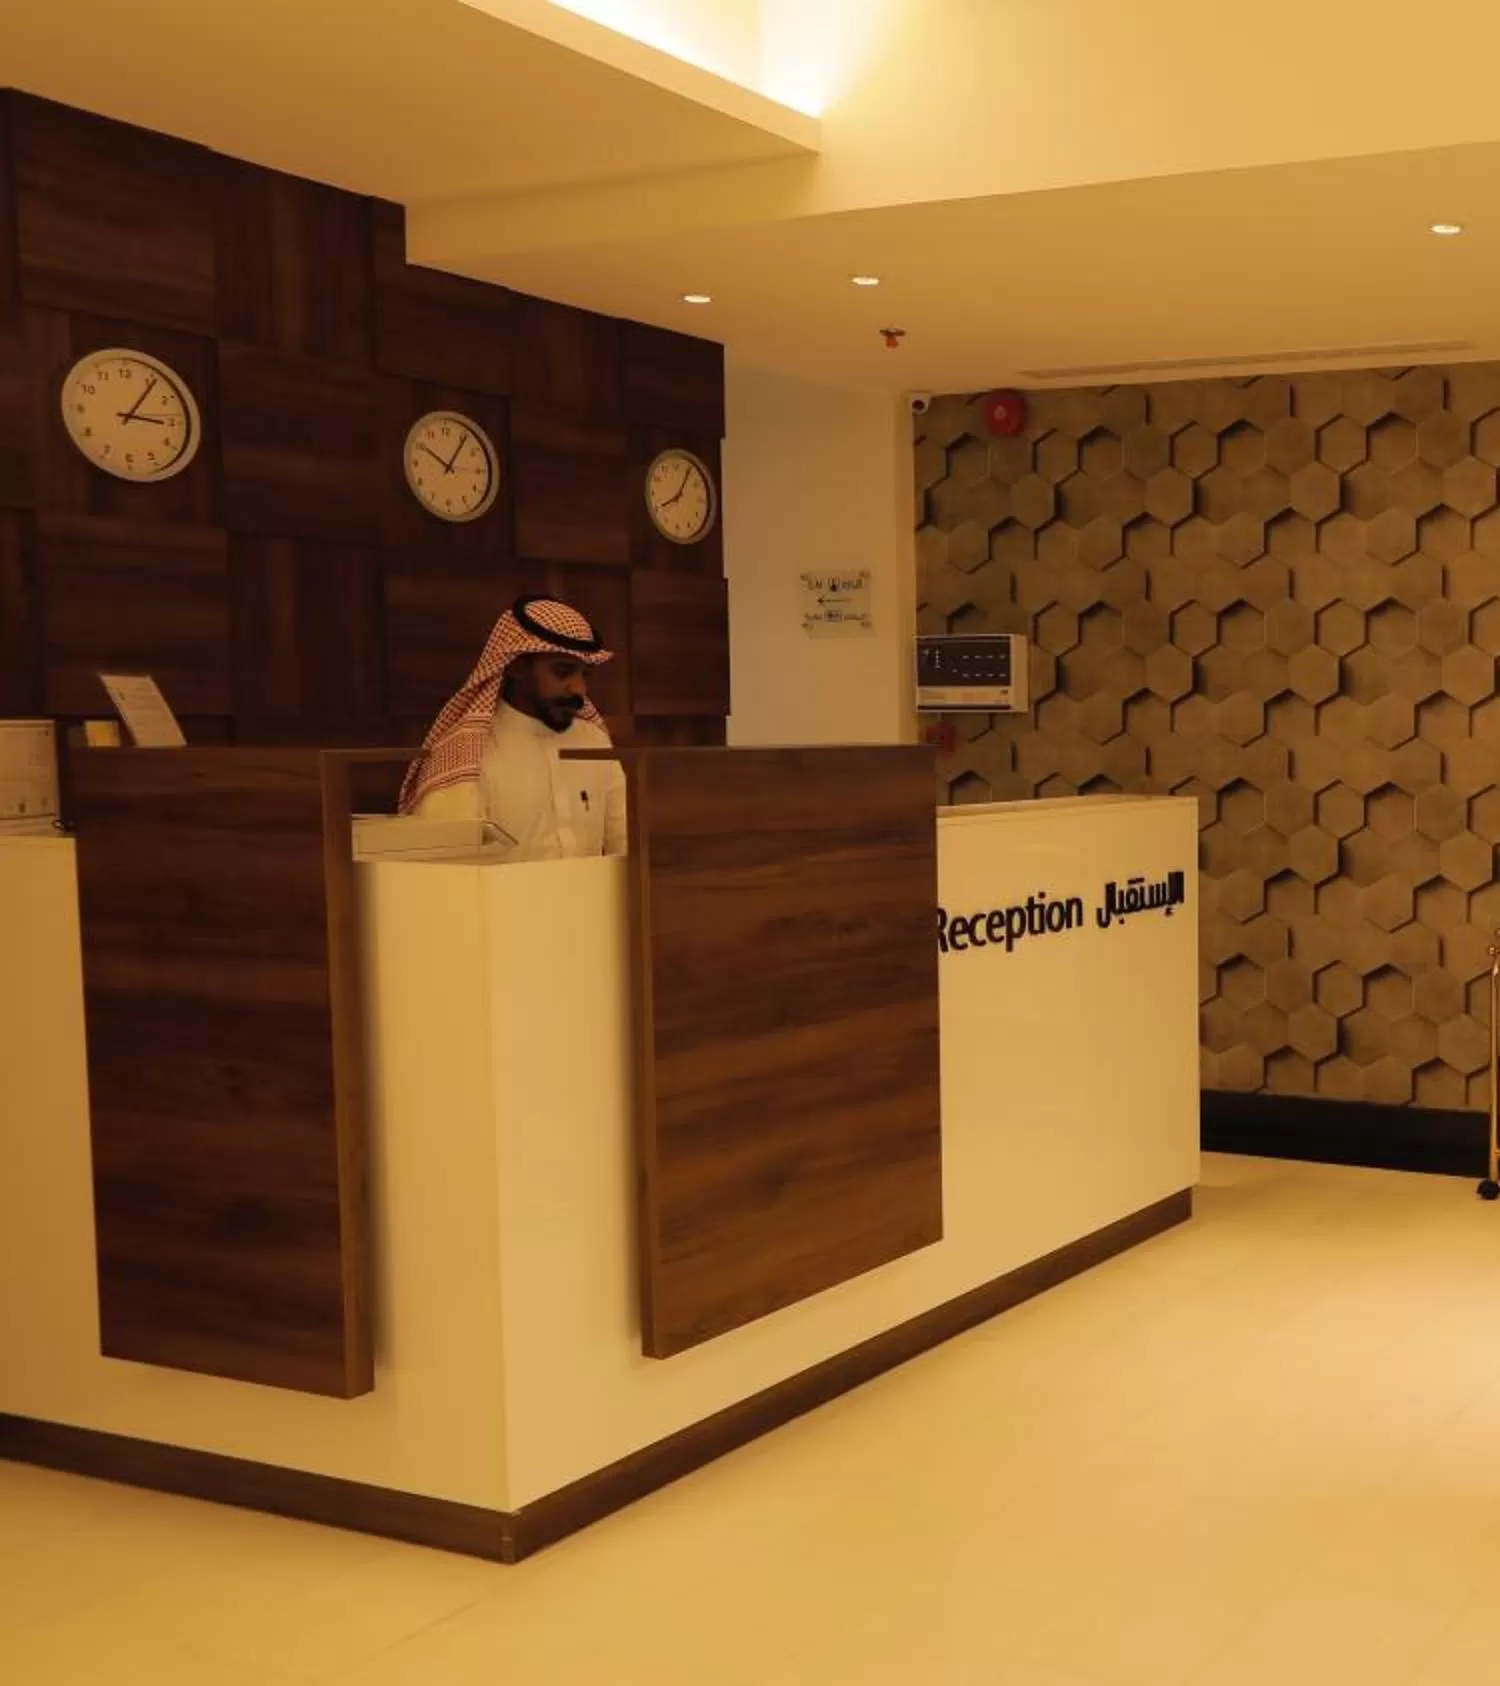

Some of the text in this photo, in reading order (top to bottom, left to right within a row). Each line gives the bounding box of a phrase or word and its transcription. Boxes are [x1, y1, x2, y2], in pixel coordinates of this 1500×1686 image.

[98, 371, 109, 381] 11
[119, 368, 132, 379] 12
[82, 384, 96, 395] 10
[1097, 871, 1184, 929] الإستقبال
